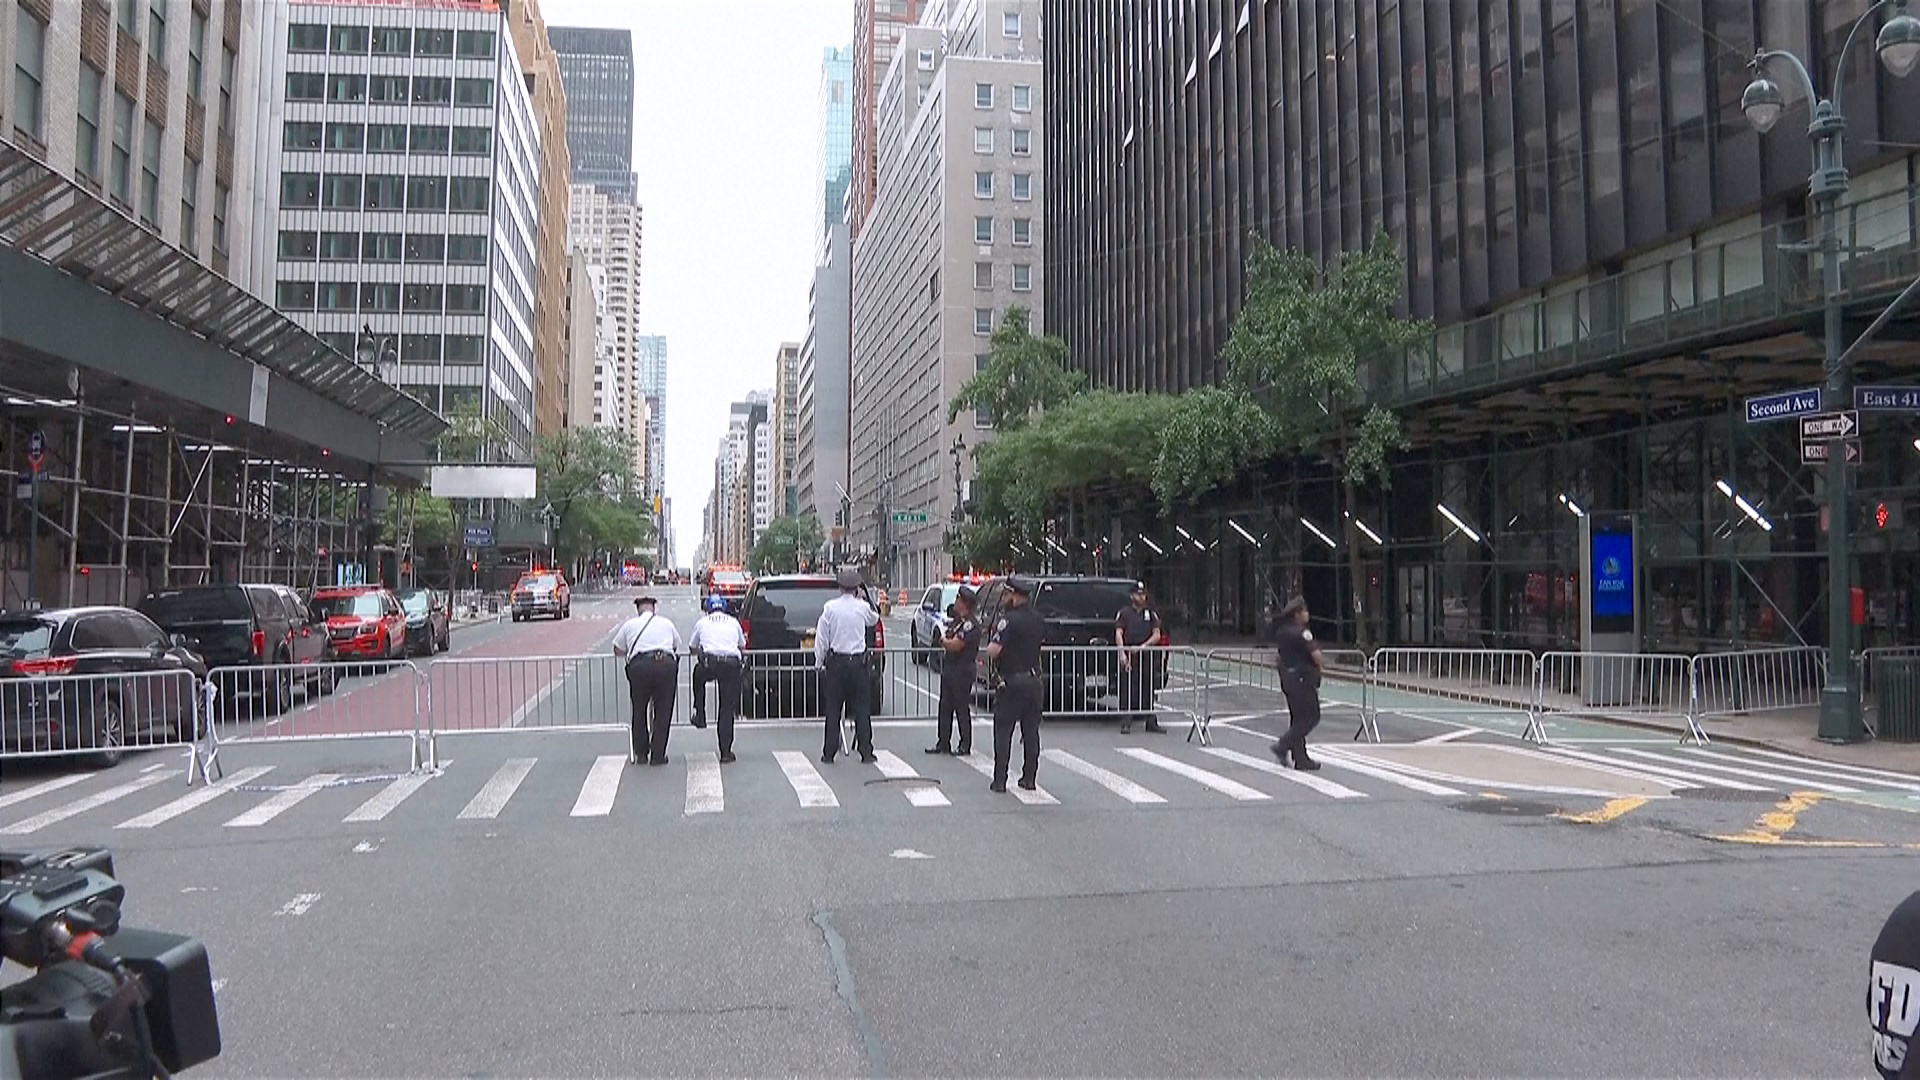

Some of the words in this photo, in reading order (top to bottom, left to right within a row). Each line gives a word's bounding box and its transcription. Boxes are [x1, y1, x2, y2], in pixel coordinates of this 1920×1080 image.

[1750, 398, 1791, 417] Second
[1793, 397, 1815, 411] Ave
[1863, 391, 1897, 406] East
[1808, 423, 1824, 433] ONE
[1831, 420, 1849, 431] WAY
[1871, 960, 1920, 1037] FD
